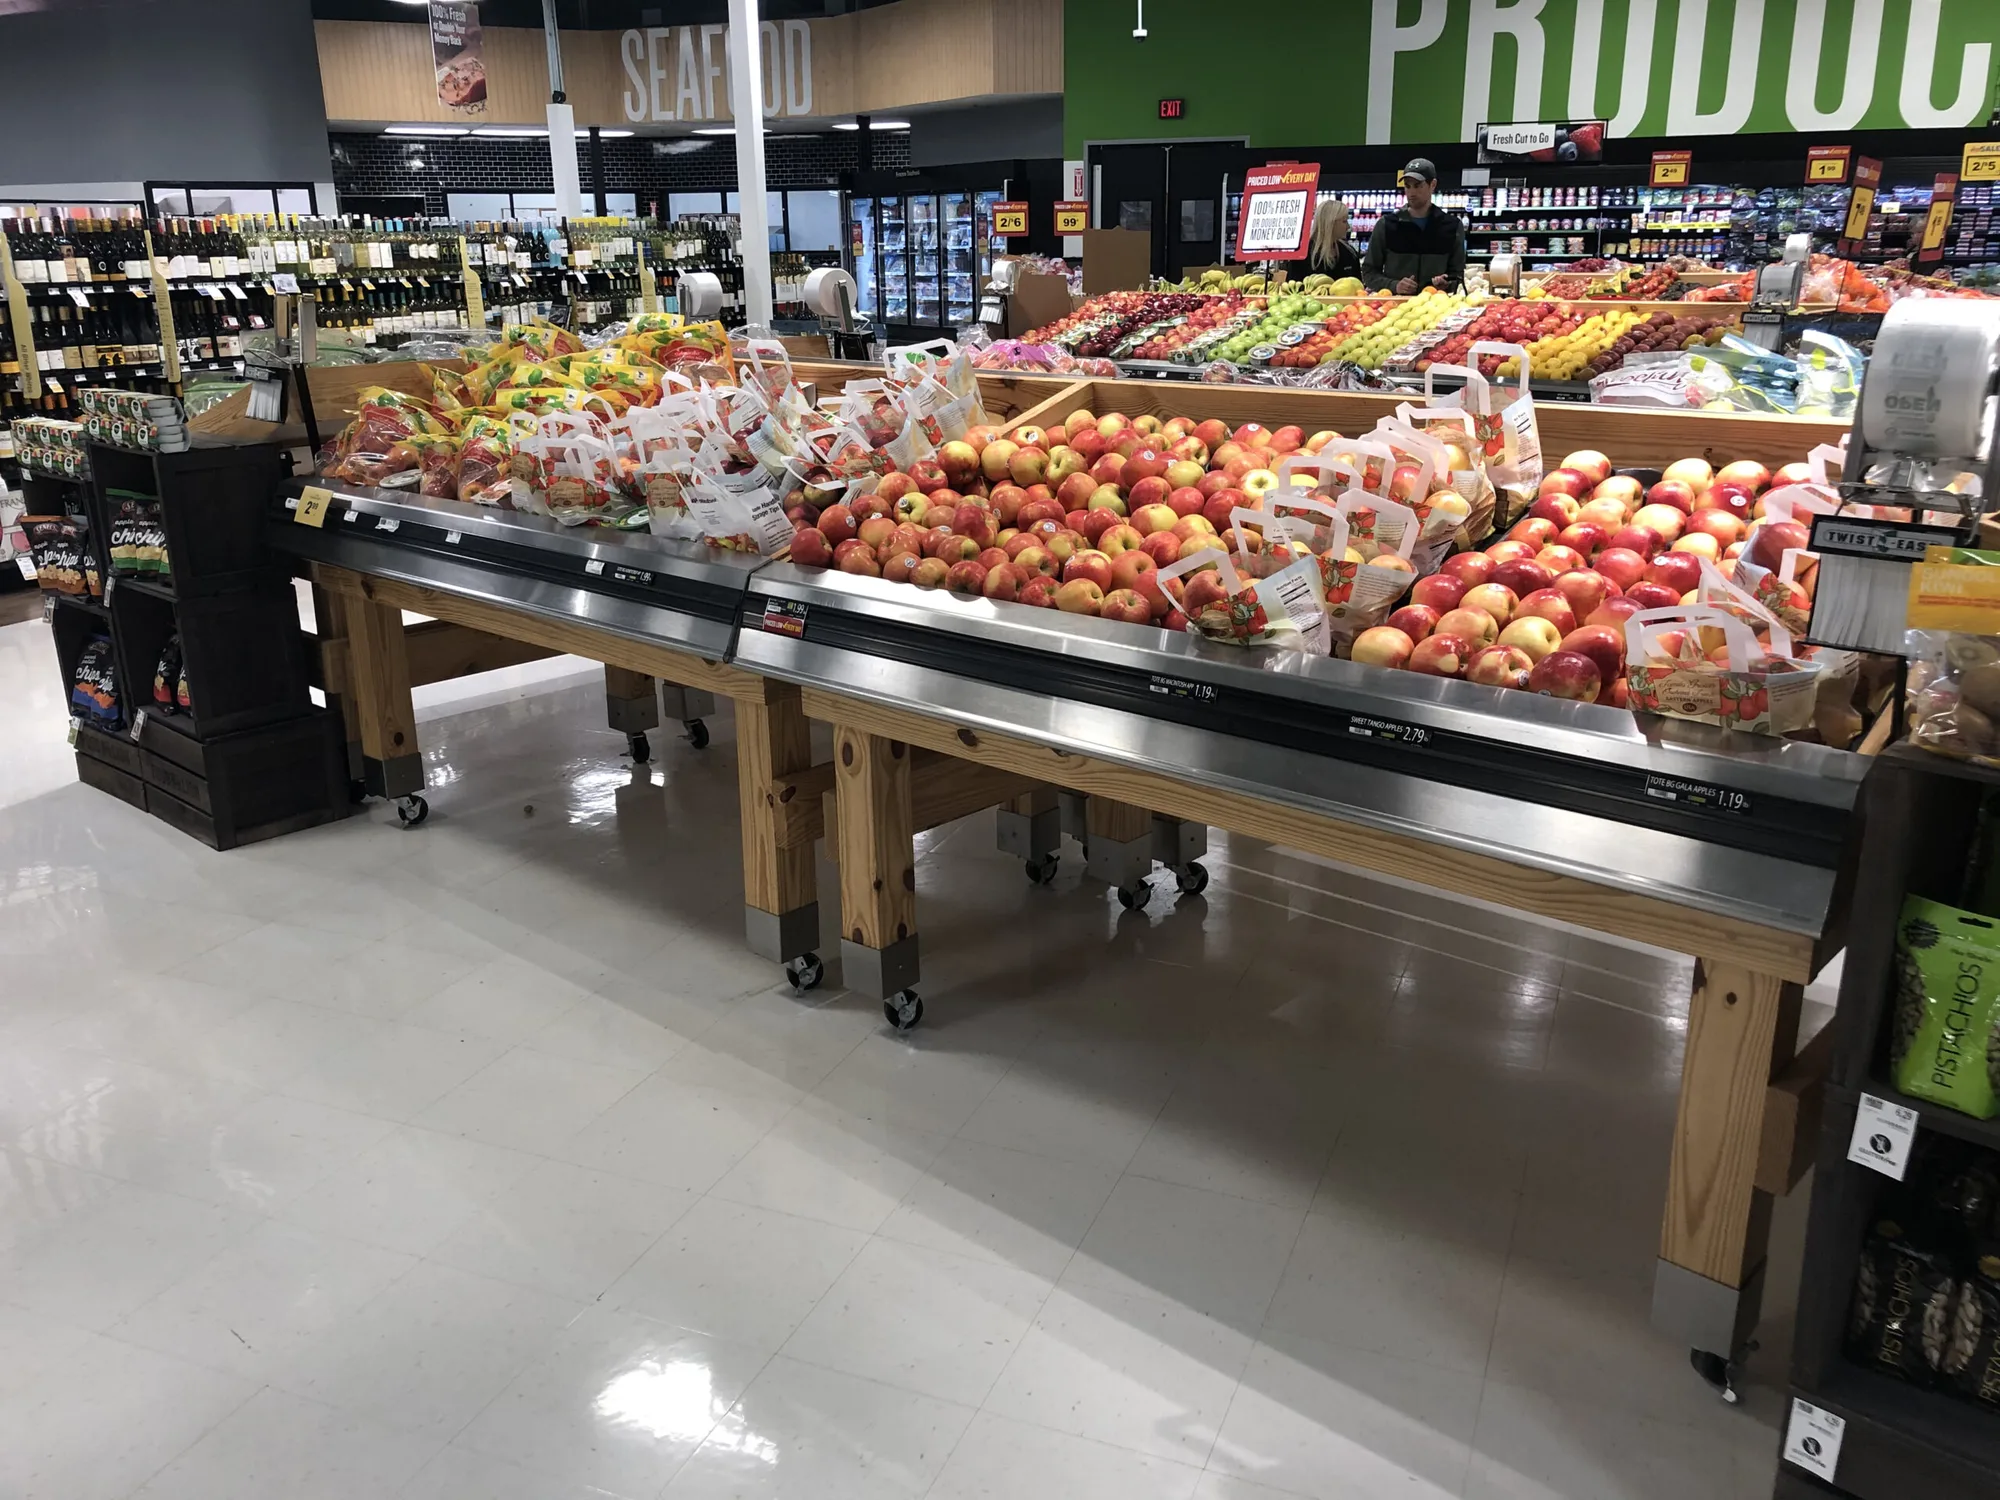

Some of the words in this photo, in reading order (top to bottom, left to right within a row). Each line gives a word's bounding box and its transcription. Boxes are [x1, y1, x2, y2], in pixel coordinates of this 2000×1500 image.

[1160, 100, 1181, 117] EXIT
[1492, 133, 1513, 145] Fresh
[1514, 133, 1528, 145] Cut
[1529, 134, 1537, 144] to
[1539, 132, 1549, 144] Go
[1247, 176, 1268, 187] PRICED
[1268, 175, 1282, 186] LOW
[1286, 173, 1304, 184] EVERY
[1304, 172, 1317, 183] DAY
[1253, 201, 1275, 215] 100%
[1275, 199, 1301, 214] FRESH
[1250, 228, 1276, 240] MONEY
[1276, 227, 1296, 240] BACK
[1828, 530, 1875, 547] TWIST
[793, 602, 805, 614] 1.99
[1195, 684, 1212, 699] 1.19
[1350, 716, 1366, 725] SWEET
[1367, 719, 1386, 729] TANGO
[1385, 723, 1404, 733] APPLES
[1403, 726, 1425, 743] 2.79
[1650, 775, 1667, 787] TOTE
[1666, 778, 1676, 789] BG
[1676, 780, 1693, 793] GALA
[1693, 783, 1716, 798] APPLES
[1718, 789, 1744, 809] 1.19
[1931, 961, 1984, 1090] PISTACHIOS
[1877, 1256, 1921, 1367] PISTACHIOS
